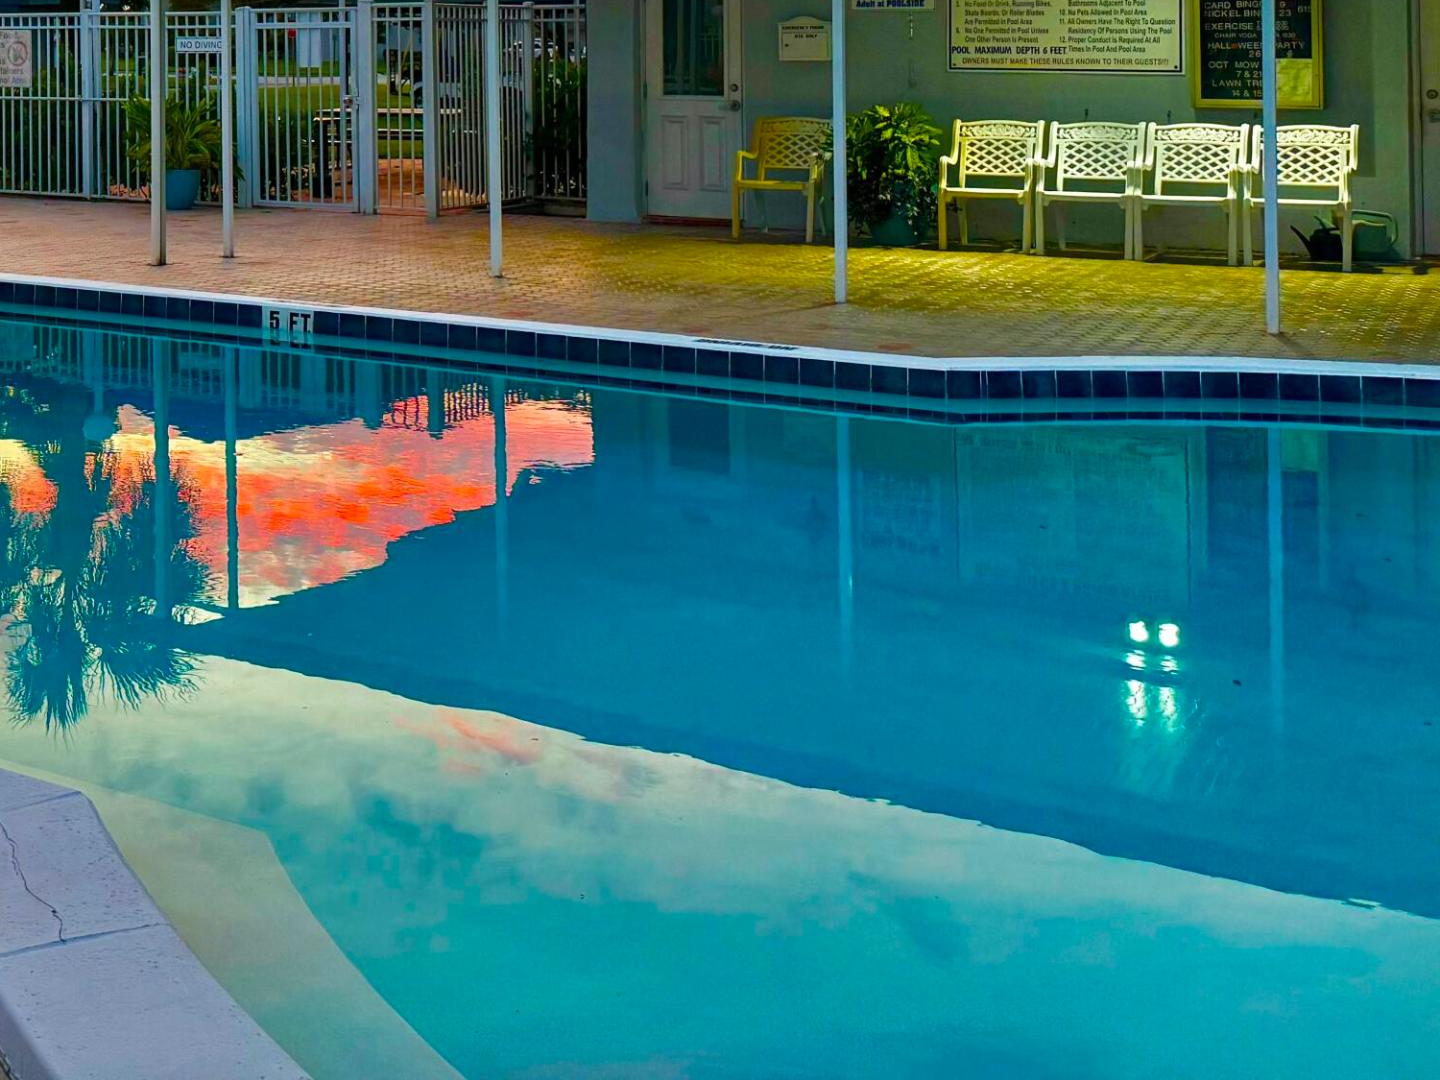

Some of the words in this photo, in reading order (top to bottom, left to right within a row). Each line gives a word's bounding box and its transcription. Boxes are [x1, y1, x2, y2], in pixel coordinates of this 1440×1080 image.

[1205, 1, 1231, 9] CARD
[1236, 0, 1262, 8] BING
[1208, 42, 1262, 50] HALLWEE
[1208, 61, 1228, 69] OCT
[270, 311, 280, 329] 5
